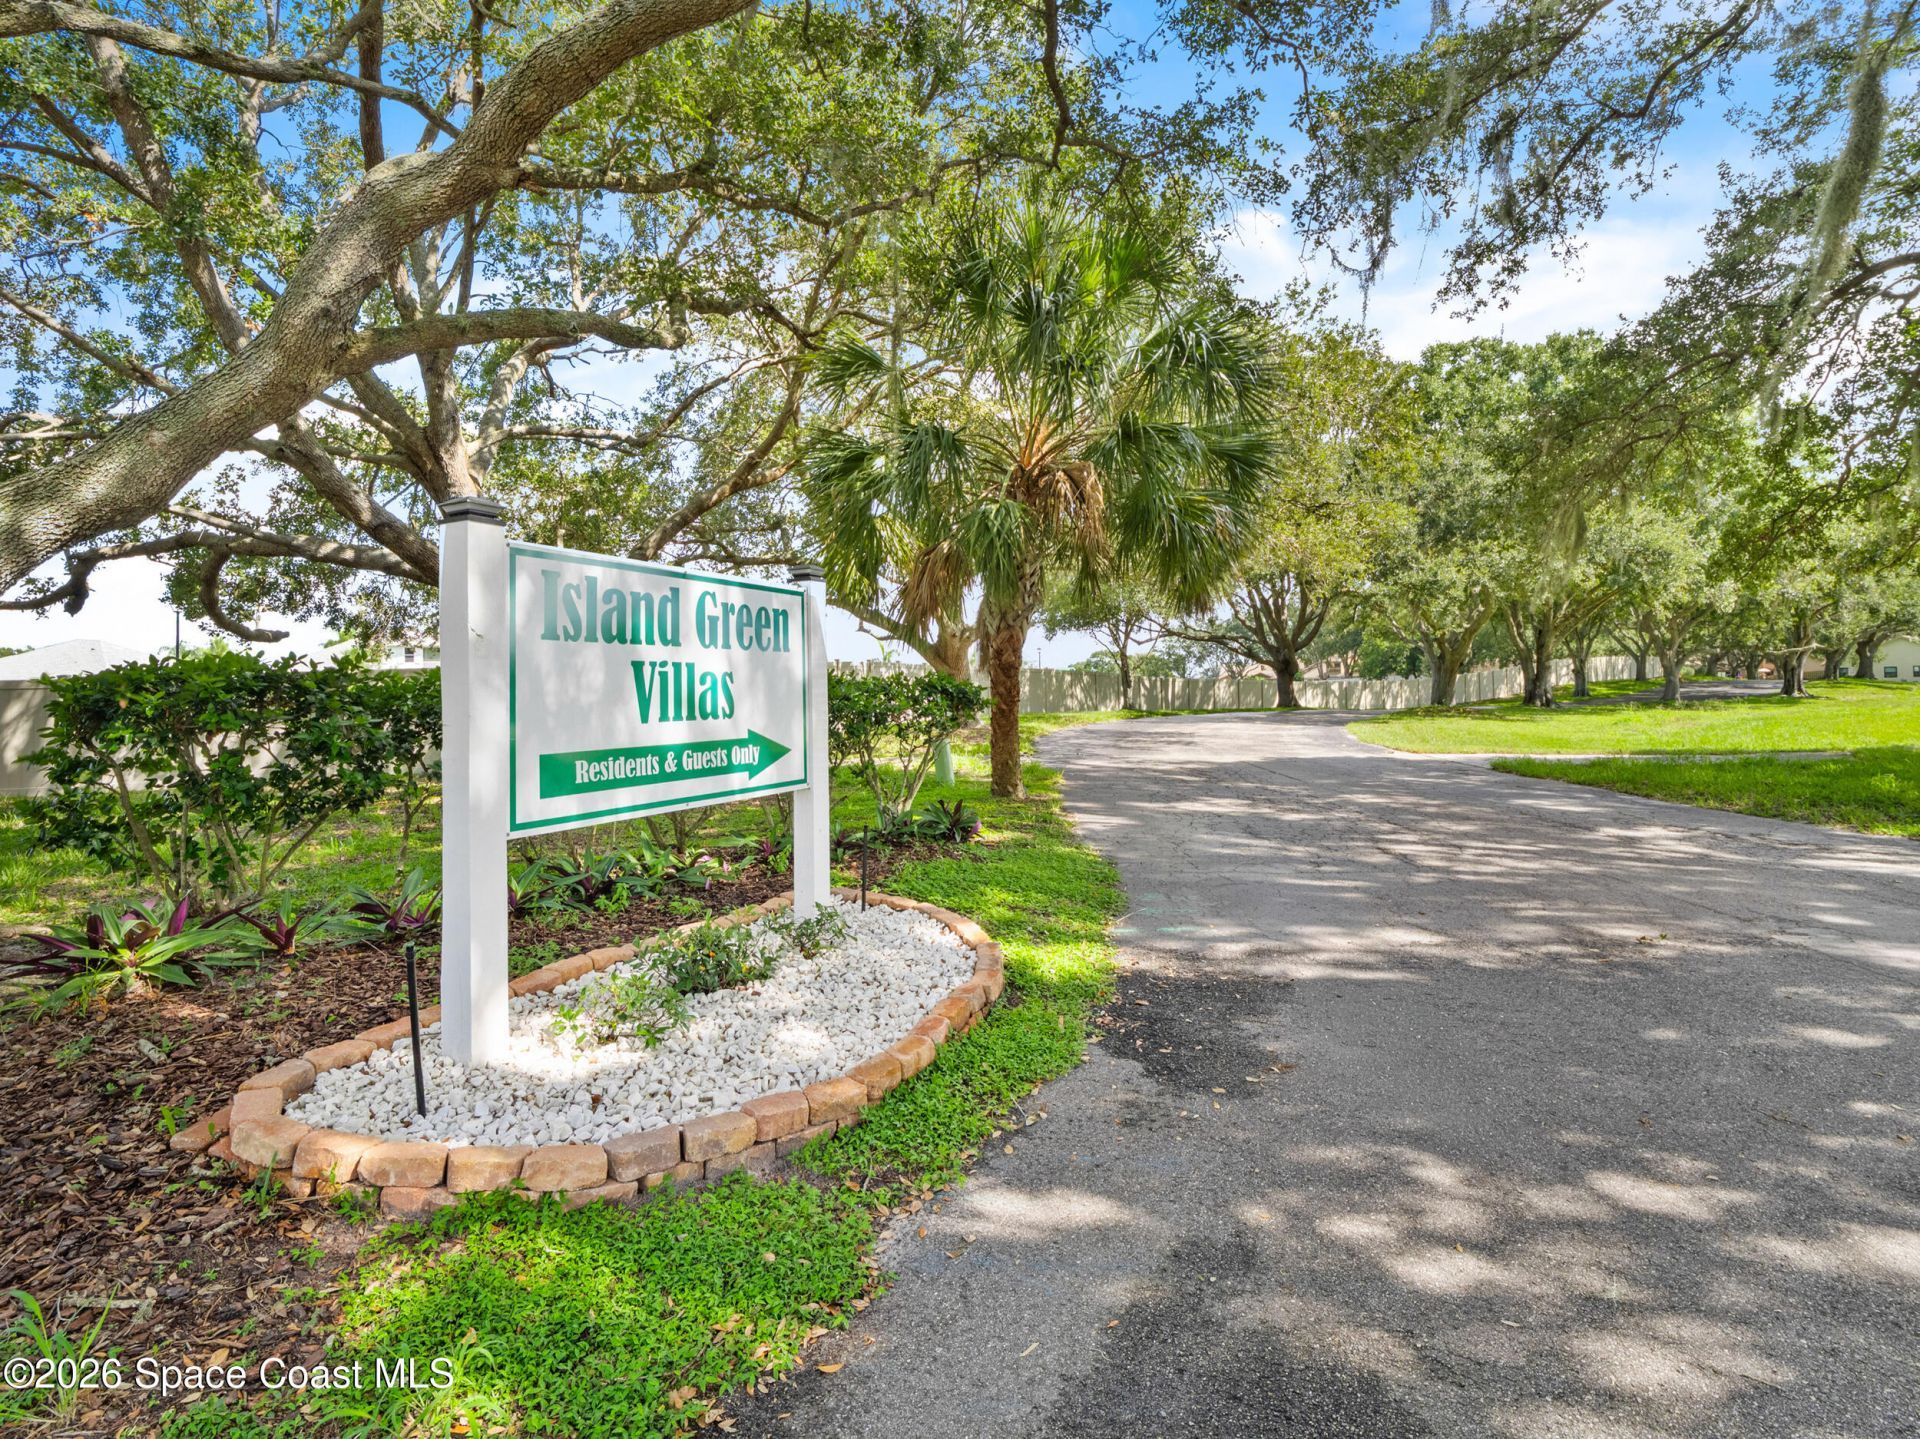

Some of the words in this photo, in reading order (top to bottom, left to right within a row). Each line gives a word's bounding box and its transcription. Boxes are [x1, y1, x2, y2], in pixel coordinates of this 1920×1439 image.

[541, 570, 682, 647] Island
[695, 590, 790, 652] Green
[631, 660, 735, 724] Villas
[575, 753, 659, 784] Residents
[664, 752, 678, 773] &
[682, 745, 728, 771] Guests
[731, 744, 760, 766] Only
